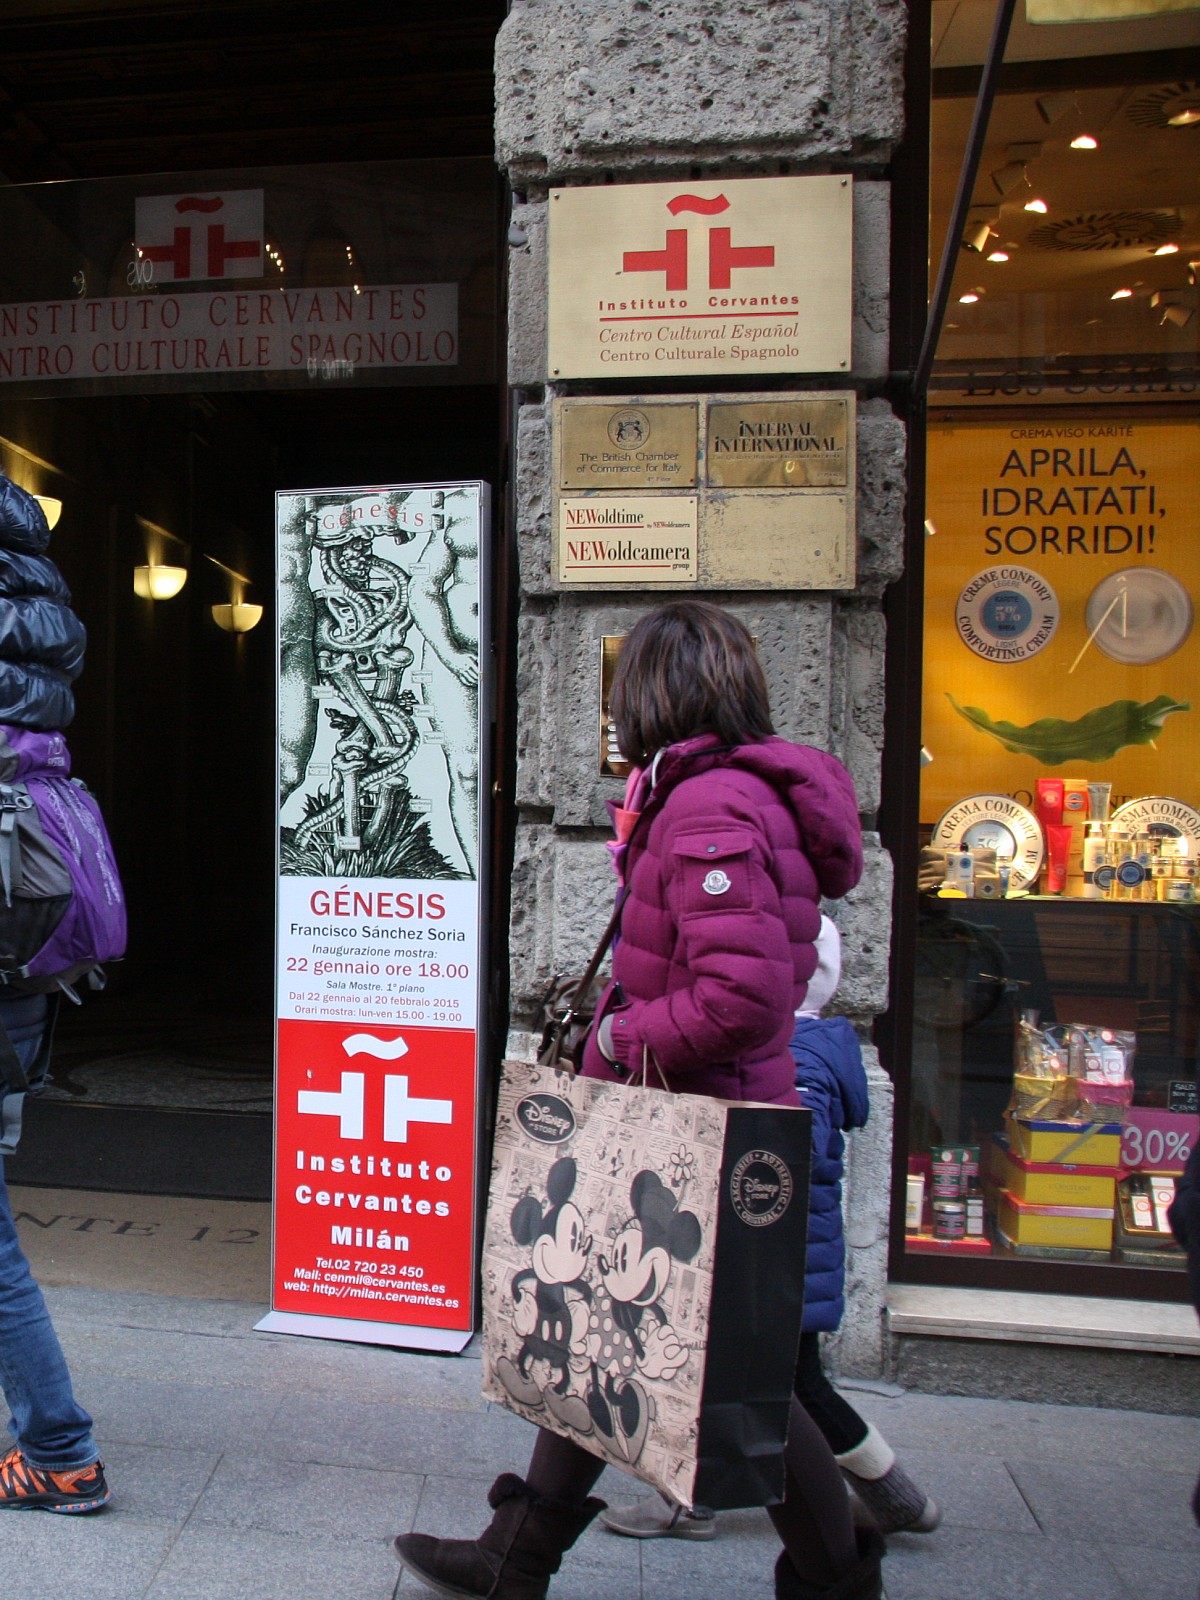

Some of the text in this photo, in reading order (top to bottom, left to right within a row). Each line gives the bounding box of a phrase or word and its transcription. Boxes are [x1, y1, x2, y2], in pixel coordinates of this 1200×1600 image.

[209, 288, 427, 327] CERVANTES
[599, 295, 799, 311] Instituto Cervantes
[600, 323, 799, 343] Centro Cultural Español
[92, 336, 271, 373] CULTURALE
[290, 330, 456, 365] SPAGNOLO
[600, 345, 799, 362] Centro Culturale Spagnolo
[1011, 429, 1054, 439] CREMA
[1055, 428, 1084, 438] VISO
[580, 452, 679, 462] The British Chamber
[1000, 448, 1147, 479] APRILA,
[577, 463, 681, 474] of Commerce for Italy
[982, 486, 1166, 518] IDRATATI,
[566, 509, 644, 524] NEWoldtime
[566, 541, 690, 561] NEWoldcamera
[985, 525, 1155, 555] SORRIDI!
[1001, 569, 1052, 602] CONFORT
[960, 615, 1054, 659] COMFORTING CREAM
[941, 800, 1037, 840] CREMA COMFORT
[310, 884, 446, 920] GÉNESIS
[290, 923, 465, 942] Francisco Sánchez Soria
[312, 944, 438, 959] Inaugurazione mostra:
[286, 957, 469, 979] 22 gennaio ore 18.00
[326, 980, 346, 990] Sala
[349, 981, 383, 991] Mostre.
[399, 984, 425, 994] piano
[289, 992, 459, 1008] Dal 22 gennaio al 20 febbraio 2015
[294, 1005, 317, 1014] Orari
[320, 1007, 356, 1016] mostra:
[358, 1008, 393, 1019] lun-ven
[395, 1010, 425, 1020] 15.00
[433, 1012, 462, 1022] 19.00
[533, 1125, 558, 1136] STORE
[1122, 1126, 1191, 1166] 30%
[296, 1150, 452, 1182] Instituto
[732, 1154, 789, 1224] EXCLUSIVE AUTHENTIC ORIGINAL
[295, 1185, 450, 1217] Cervantes
[184, 1226, 260, 1244] 12
[331, 1226, 409, 1251] Milán
[315, 1257, 424, 1279] Tel.02 720 23 450
[294, 1268, 446, 1294] Mail: cenmil@cervantes.es
[284, 1281, 459, 1309] web: http://milan.cervantes.es
